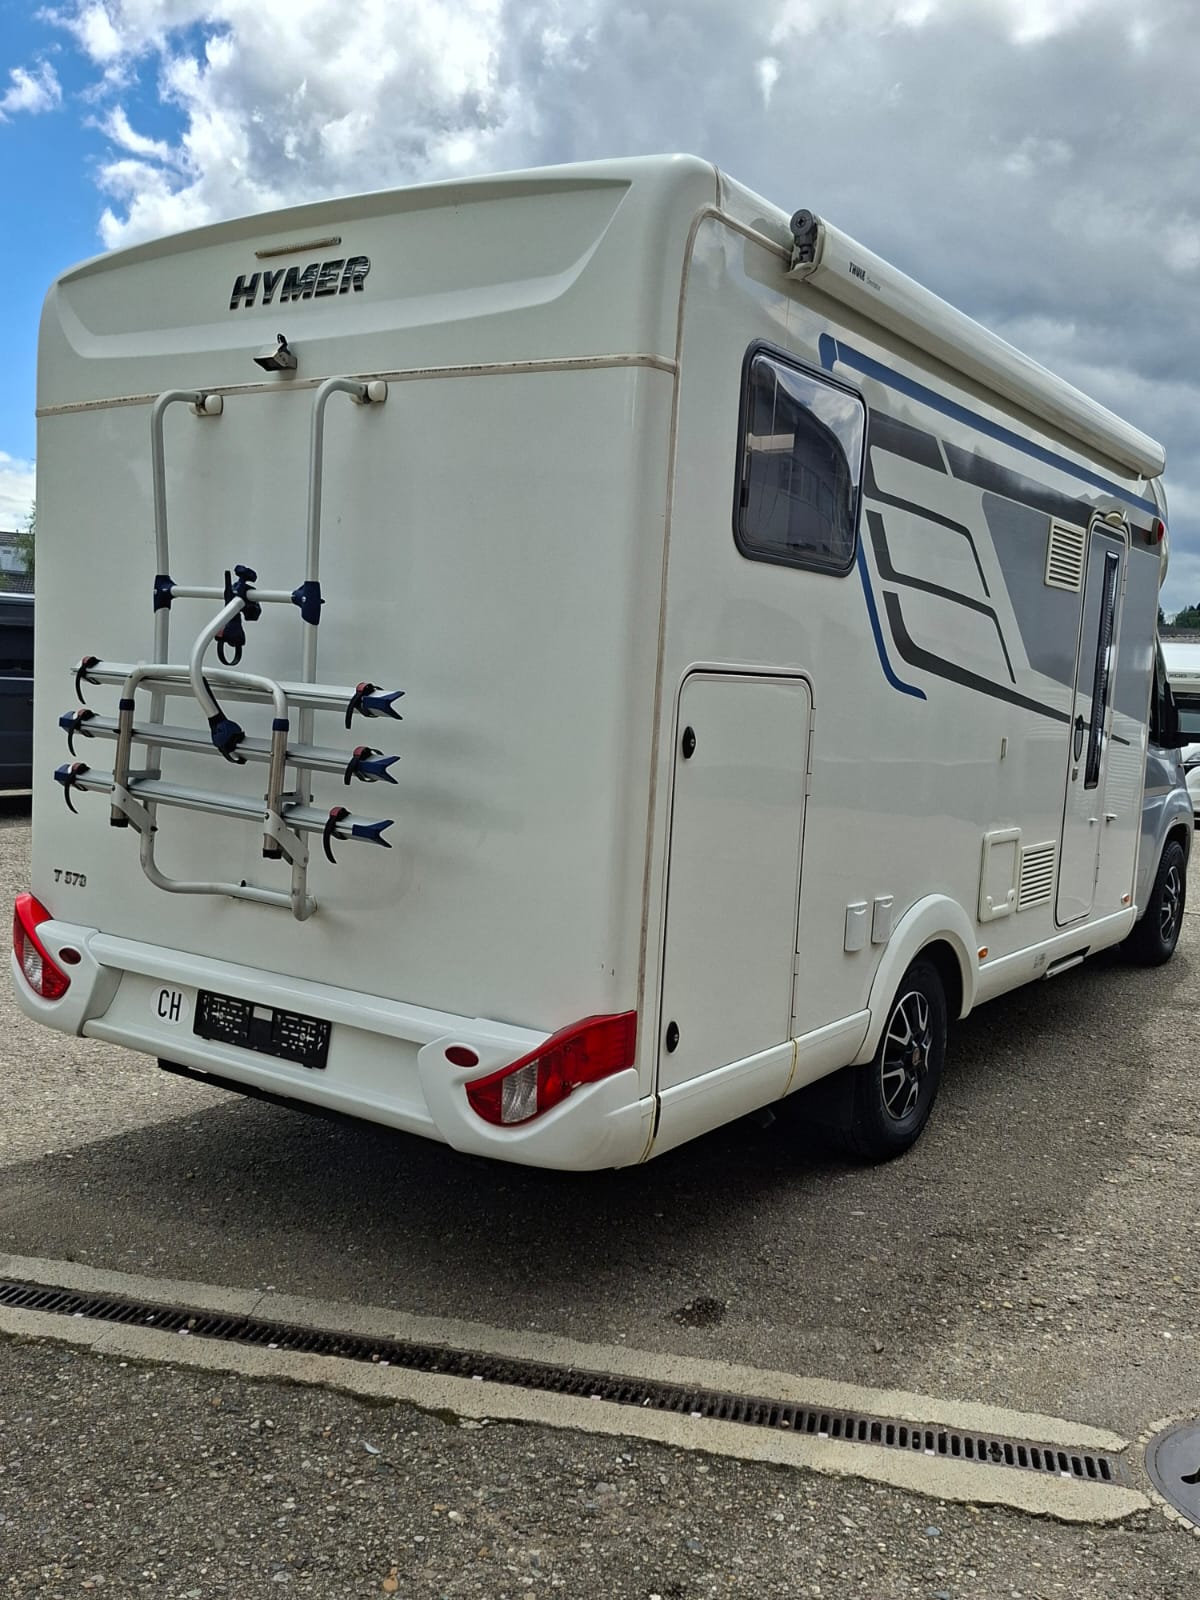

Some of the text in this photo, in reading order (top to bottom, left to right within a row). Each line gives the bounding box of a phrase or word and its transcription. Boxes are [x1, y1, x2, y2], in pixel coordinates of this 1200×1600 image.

[229, 255, 371, 311] HYMER
[54, 868, 63, 882] T
[157, 989, 182, 1022] CH
